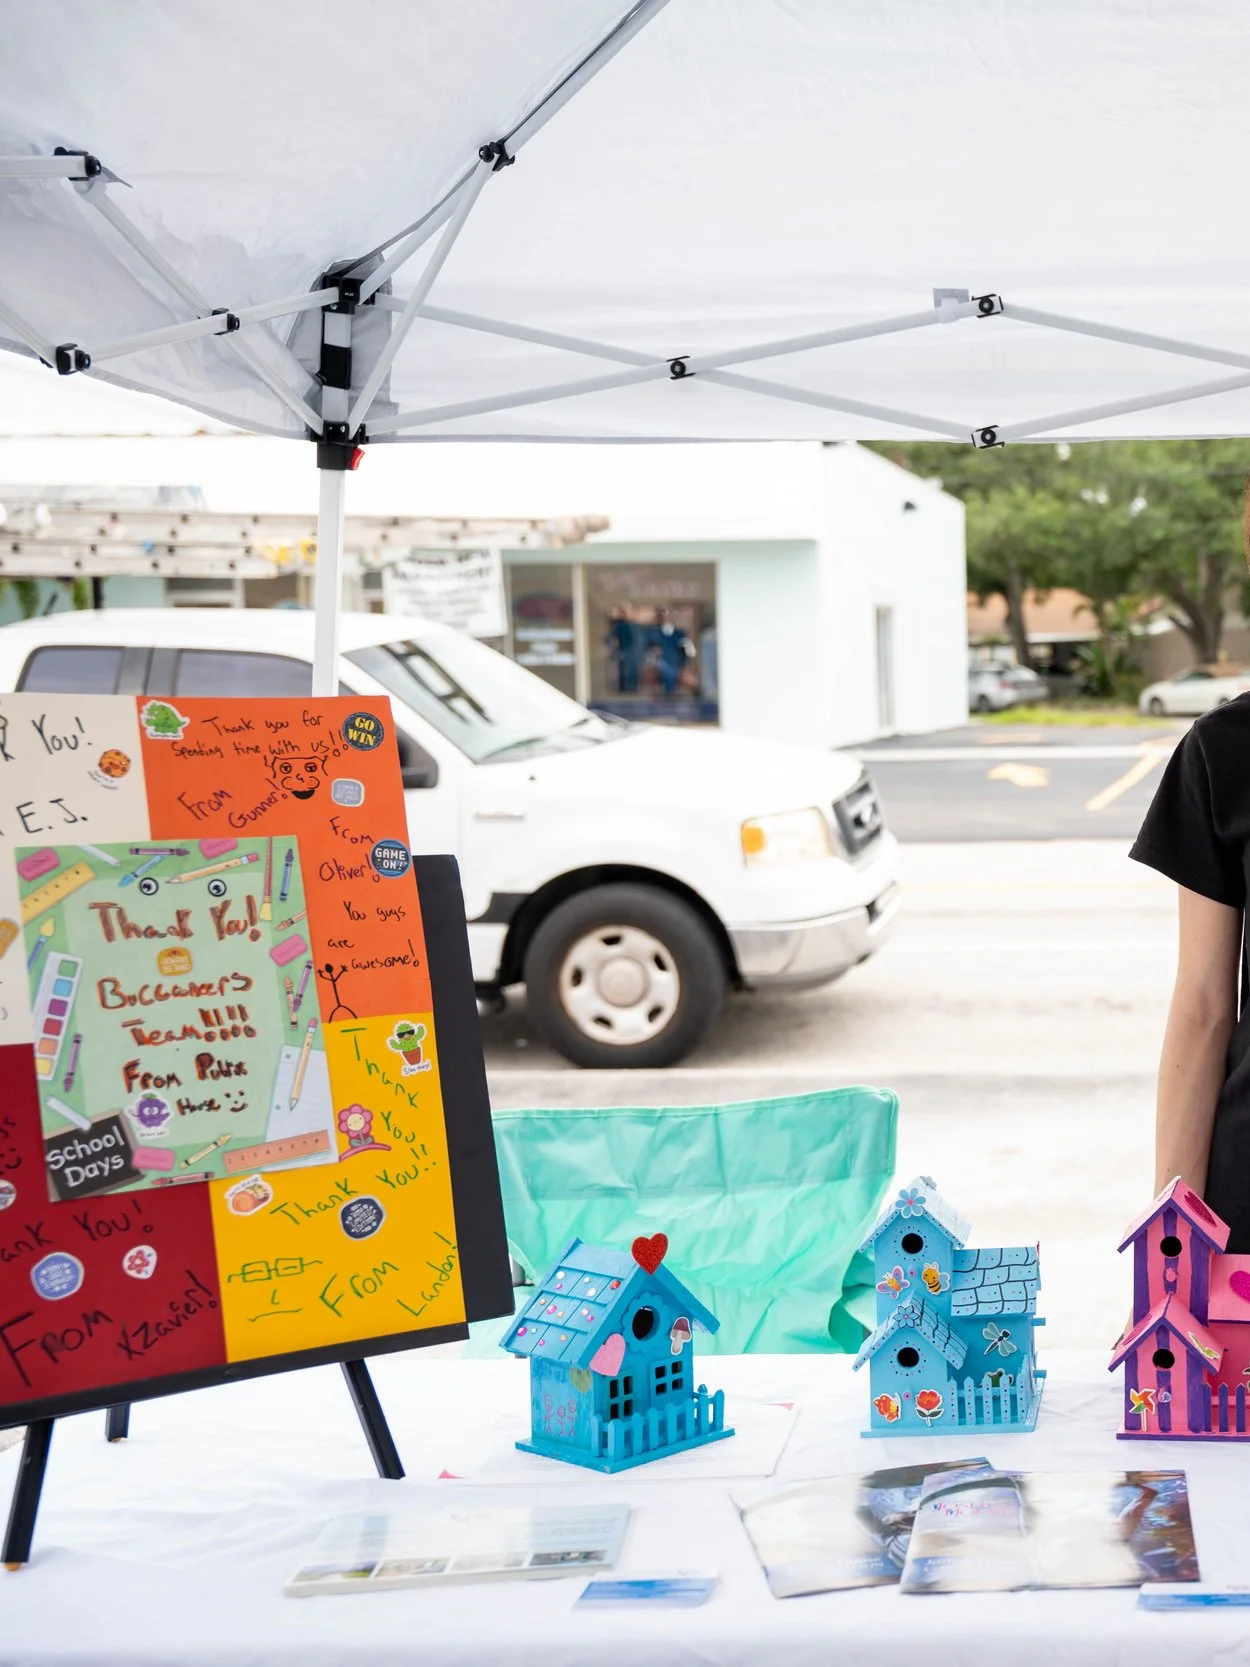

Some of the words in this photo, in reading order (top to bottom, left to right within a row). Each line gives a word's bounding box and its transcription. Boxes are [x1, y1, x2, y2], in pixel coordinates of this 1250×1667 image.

[32, 714, 92, 755] You!
[202, 716, 255, 736] Thank
[265, 720, 290, 733] you
[302, 709, 324, 727] for
[348, 729, 376, 746] WIN
[354, 717, 375, 732] GO
[234, 742, 261, 756] time
[269, 740, 301, 756] with
[16, 798, 88, 833] E.J.
[227, 777, 289, 829] Gunner!
[319, 853, 381, 884] Oliver!
[375, 848, 406, 860] GAME
[383, 858, 404, 871] ON!
[88, 901, 194, 943] Thank
[209, 894, 262, 942] You!
[343, 901, 366, 921] You
[377, 906, 406, 922] guys
[327, 939, 355, 949] are
[351, 940, 420, 970] awesome!
[97, 972, 253, 1010] Buccaneers
[46, 1125, 125, 1170] School
[64, 1154, 125, 1188] Days
[73, 1199, 154, 1241] You!
